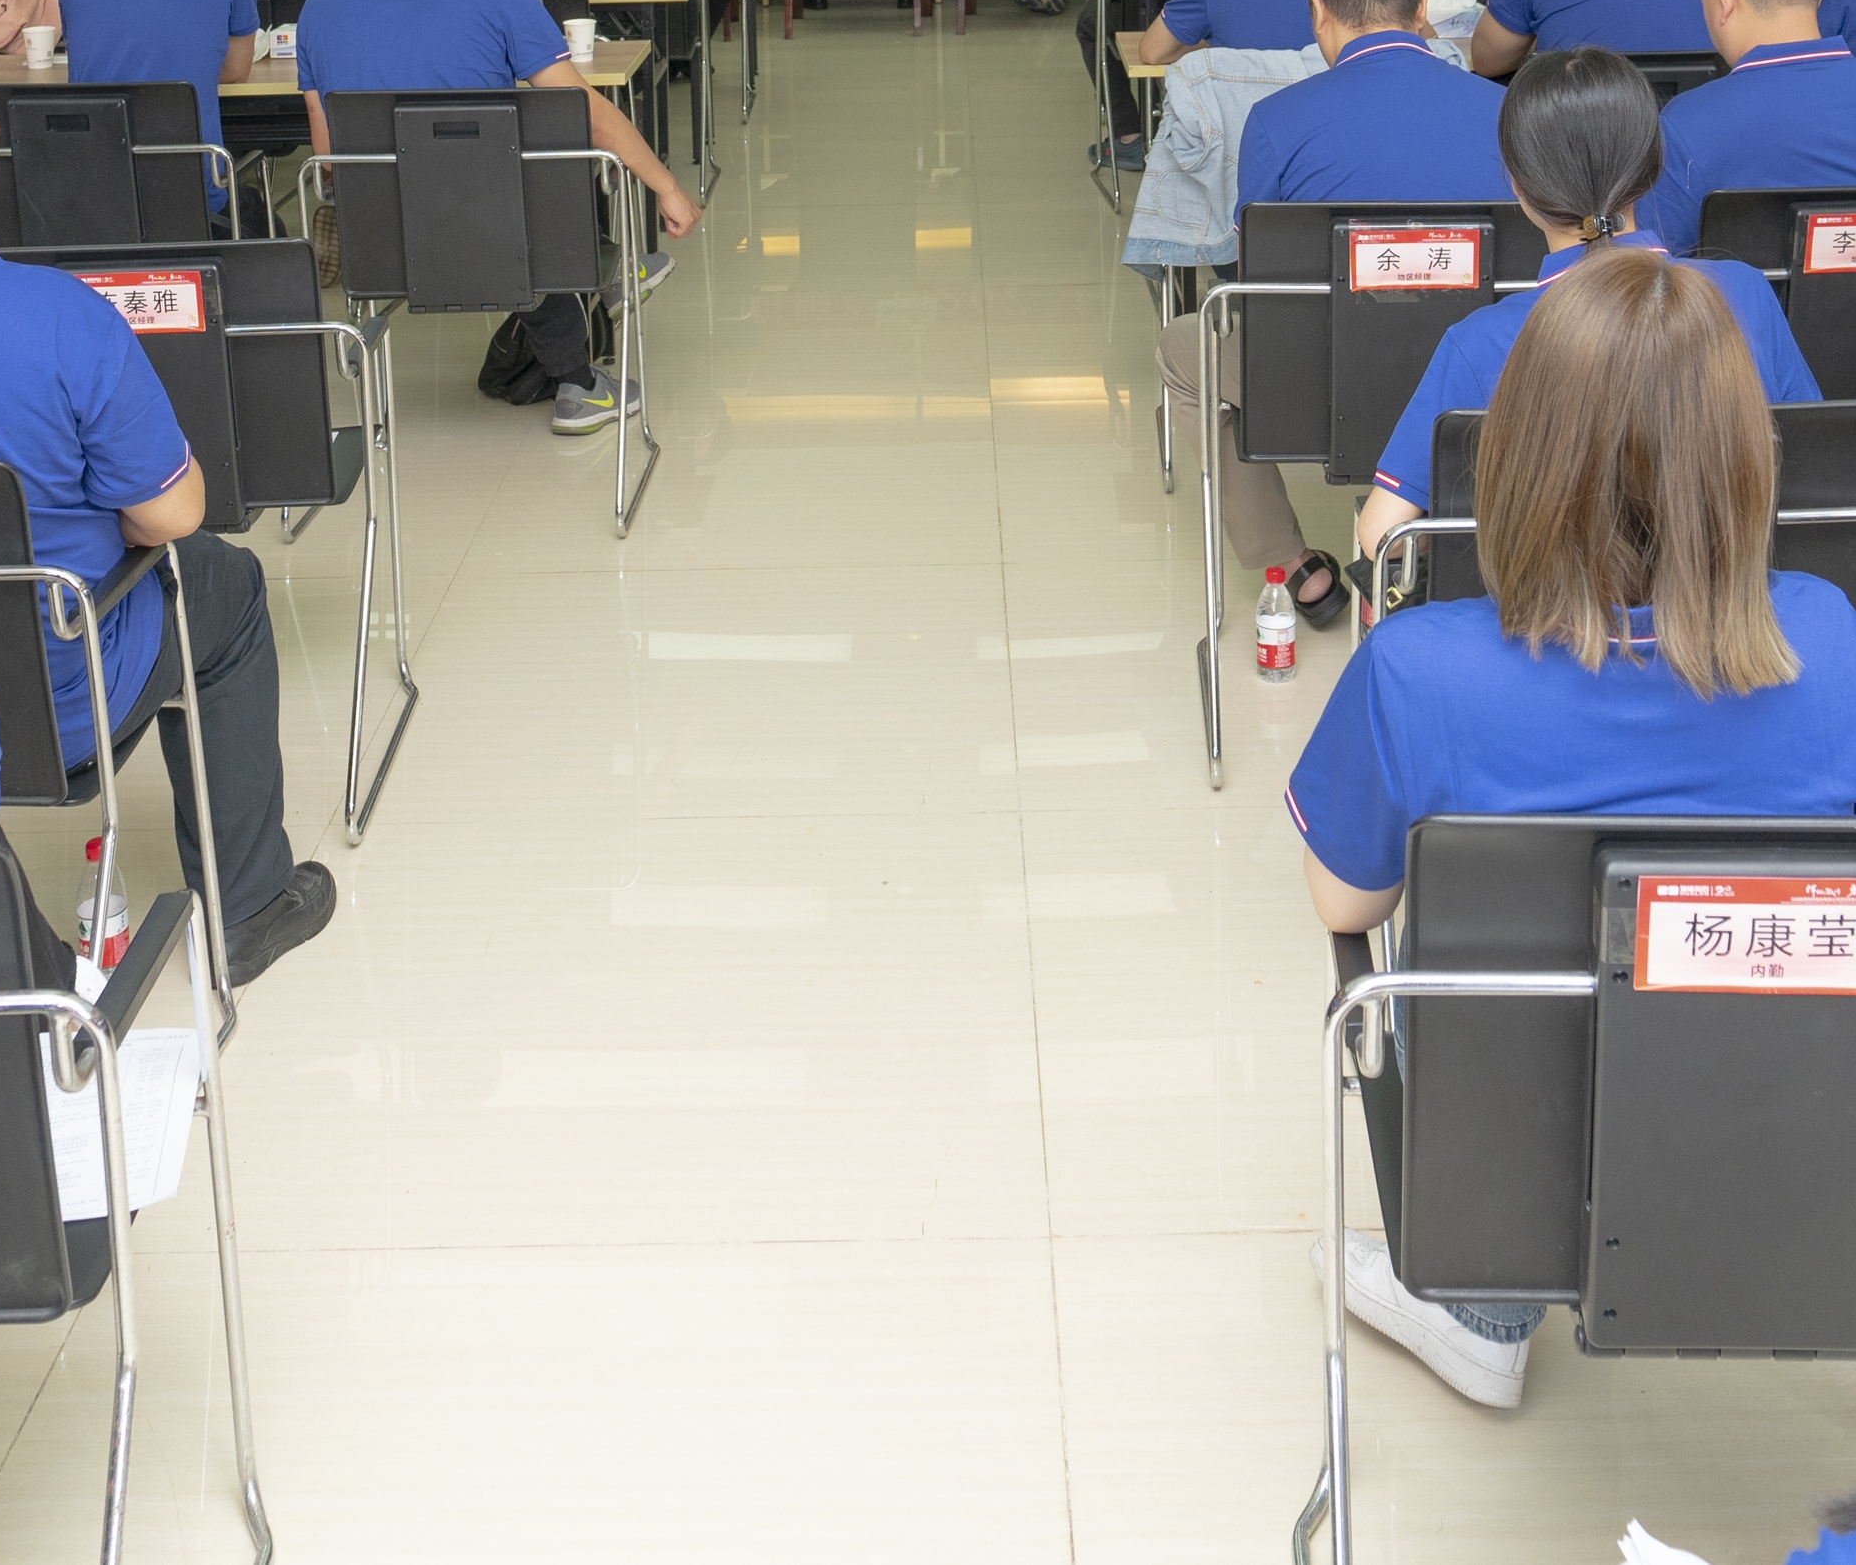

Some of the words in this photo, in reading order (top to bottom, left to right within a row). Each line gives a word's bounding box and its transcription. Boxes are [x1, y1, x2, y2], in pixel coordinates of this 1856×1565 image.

[1377, 247, 1452, 272] 余涛
[1397, 272, 1432, 282] 地区经理
[1750, 963, 1785, 980] 内勤
